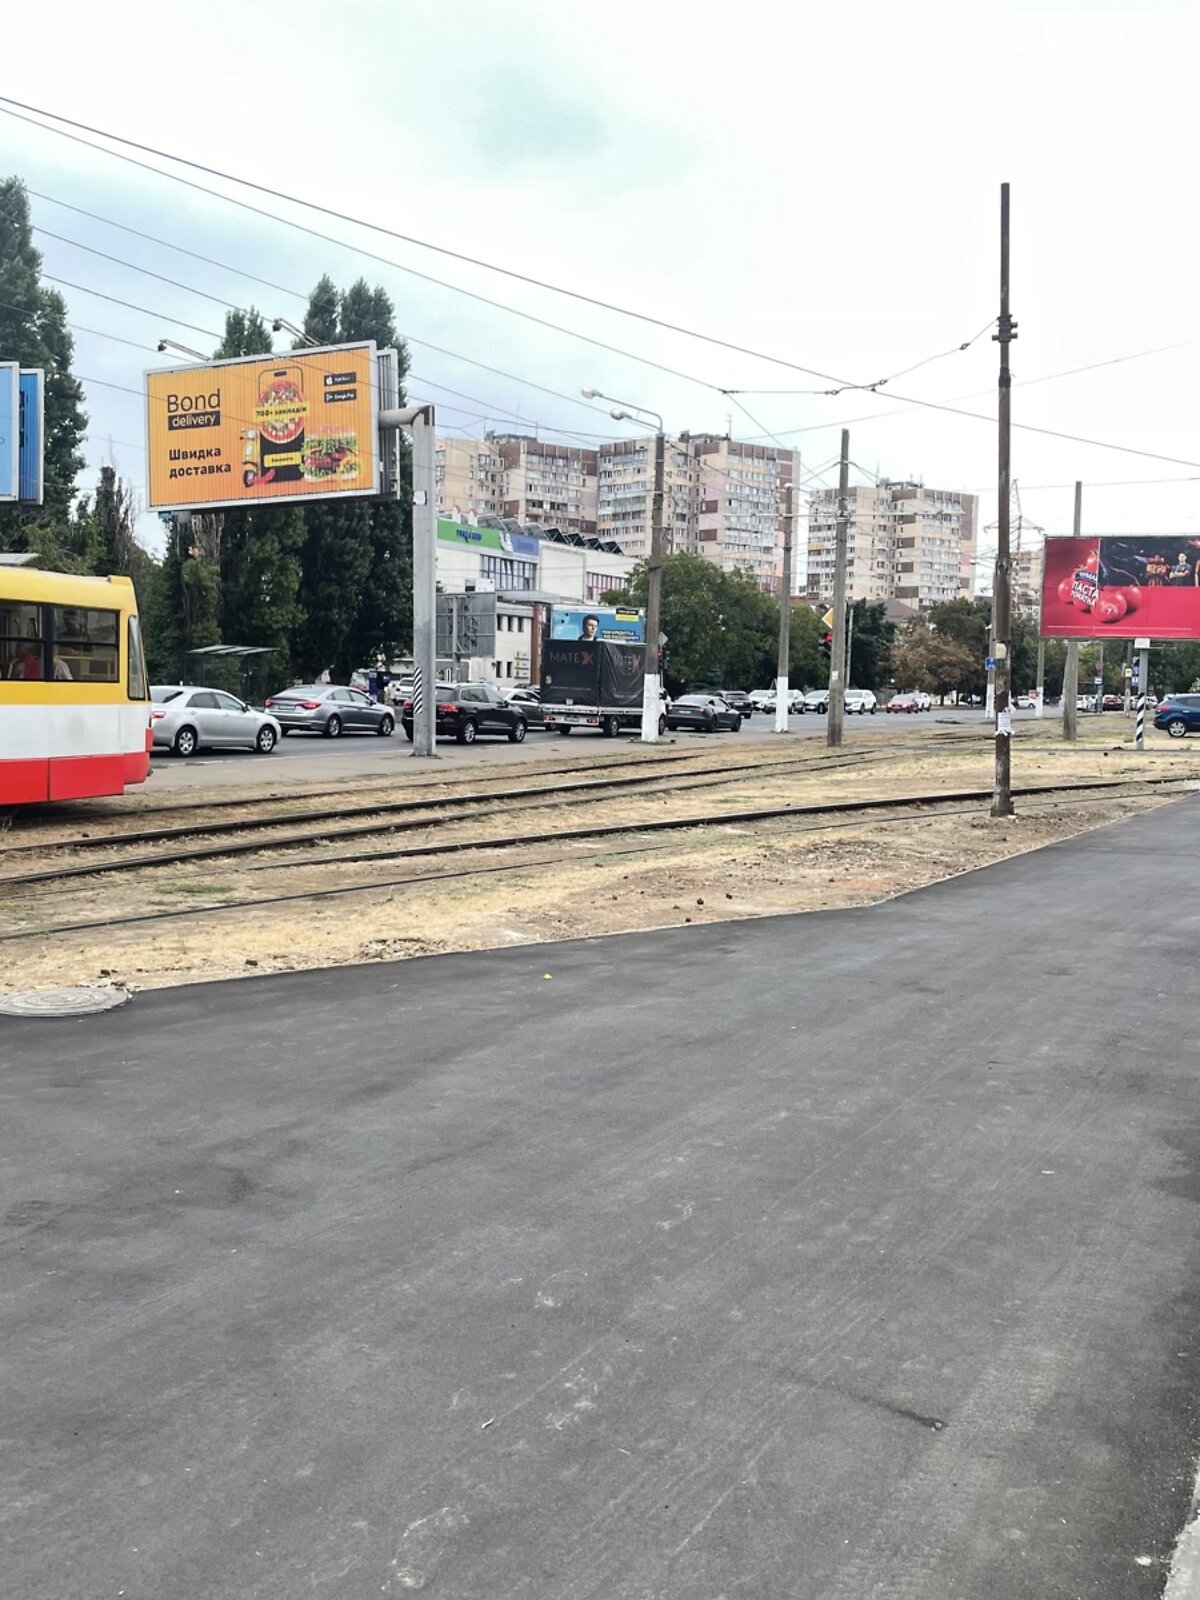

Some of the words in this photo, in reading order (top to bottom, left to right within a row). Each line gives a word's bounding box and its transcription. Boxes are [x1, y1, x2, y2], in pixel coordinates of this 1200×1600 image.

[167, 388, 221, 413] Bond
[172, 413, 217, 429] delivery
[255, 409, 273, 417] 700+
[169, 446, 222, 461] Швидка
[169, 462, 232, 479] доставка
[1071, 581, 1099, 599] ПАСТА
